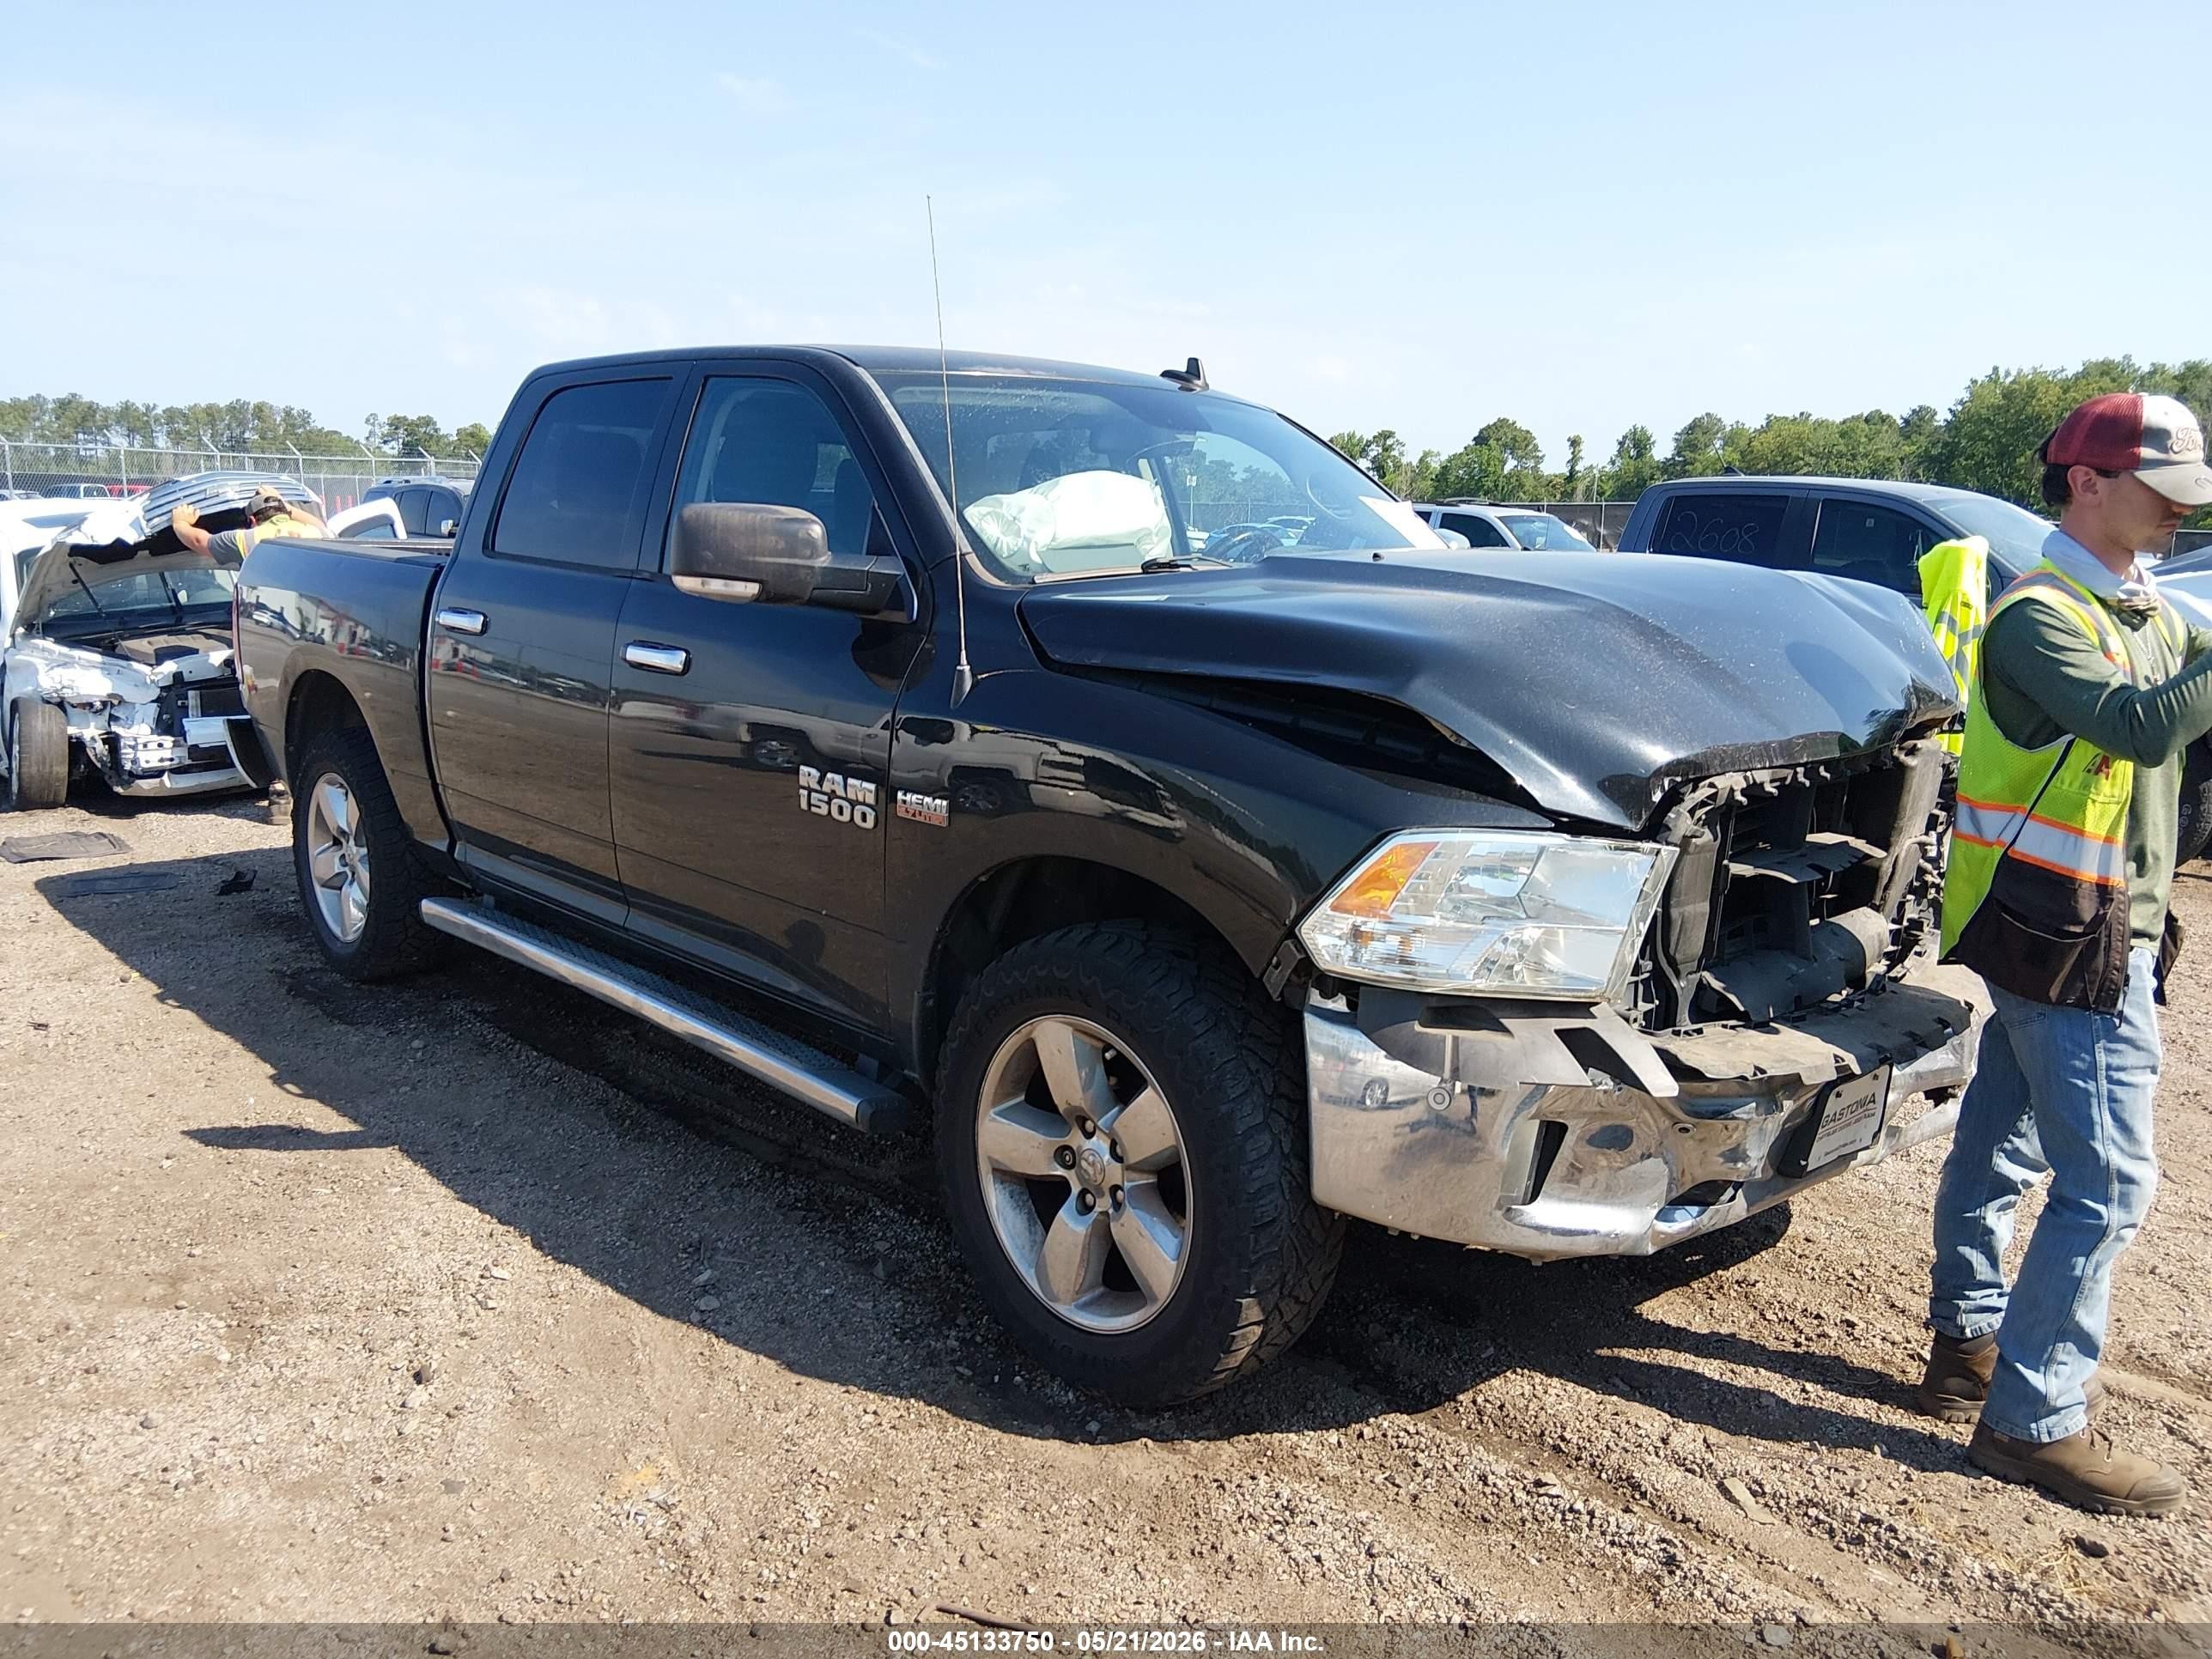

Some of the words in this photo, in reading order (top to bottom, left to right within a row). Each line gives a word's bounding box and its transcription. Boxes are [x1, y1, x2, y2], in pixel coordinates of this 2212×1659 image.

[2170, 427, 2202, 454] Fo
[1670, 511, 1759, 554] 2608
[799, 764, 877, 805] RAM
[897, 790, 949, 815] HEMI
[799, 788, 876, 830] 1500
[1820, 1091, 1876, 1129] GASTONIA
